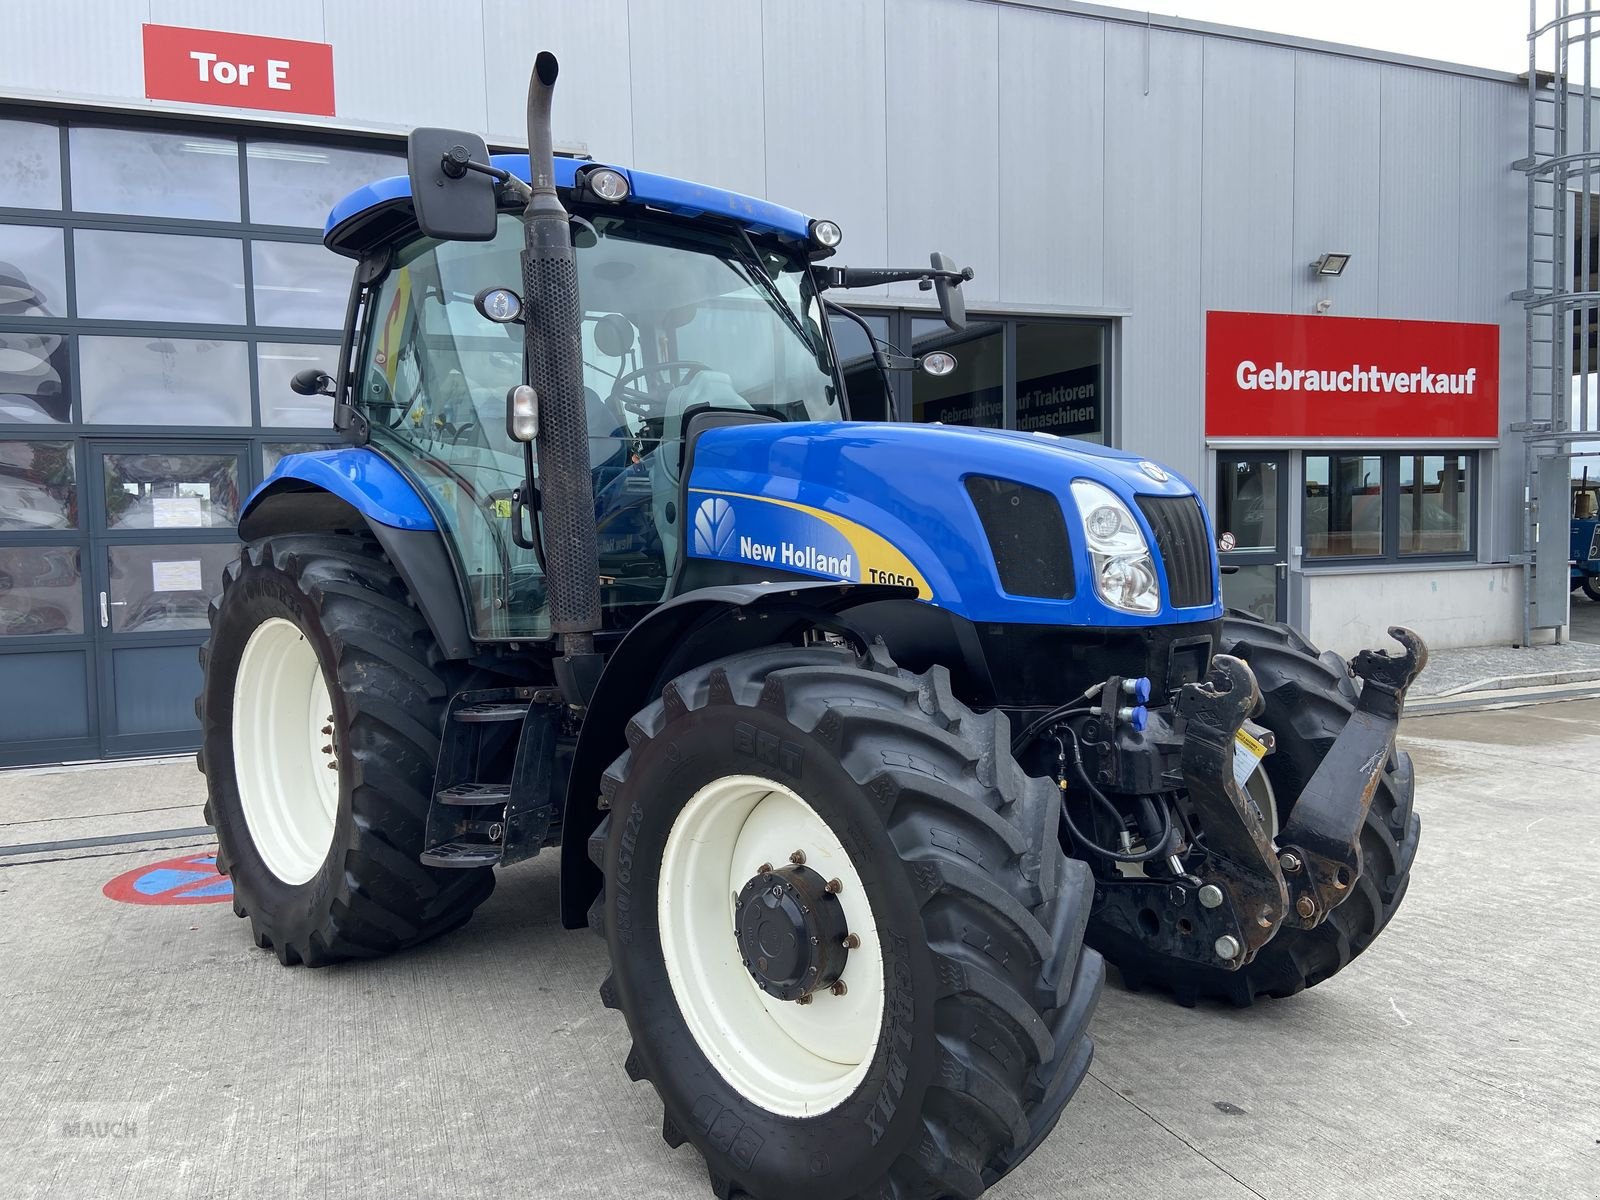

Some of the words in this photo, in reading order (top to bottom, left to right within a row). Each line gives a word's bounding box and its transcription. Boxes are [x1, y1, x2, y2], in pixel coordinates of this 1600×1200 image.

[189, 51, 255, 86] Tor
[267, 59, 292, 90] E
[1236, 360, 1476, 395] Gebrauchtverkauf
[941, 392, 1031, 423] Gebrauchtveuf
[1034, 383, 1095, 407] Traktoren
[1016, 406, 1095, 431] ndmaschinen
[740, 536, 777, 562] New
[781, 542, 852, 578] Holland
